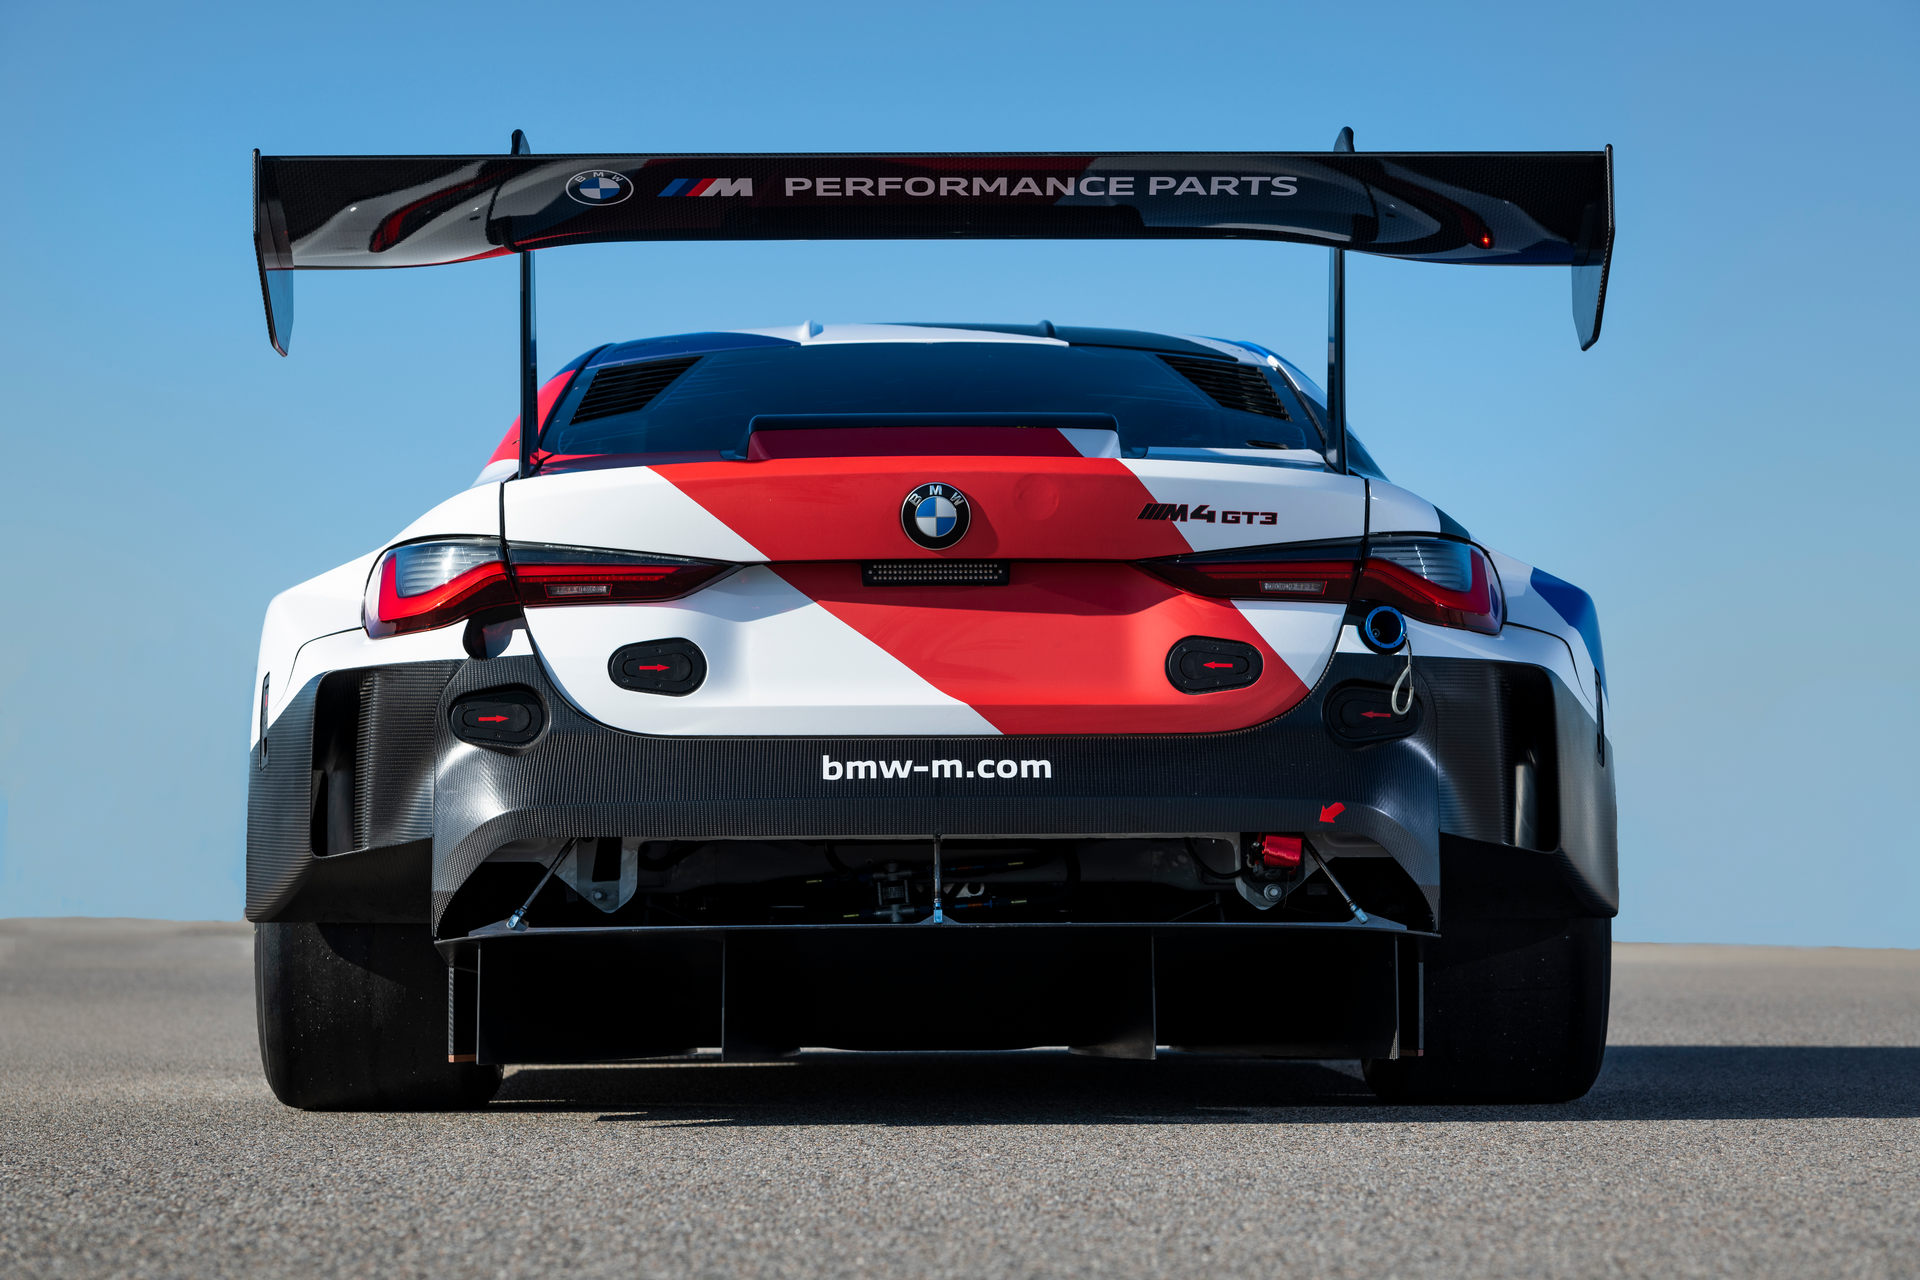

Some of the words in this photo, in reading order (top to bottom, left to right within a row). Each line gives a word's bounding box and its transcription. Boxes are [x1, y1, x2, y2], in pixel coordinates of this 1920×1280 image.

[575, 172, 624, 183] BMW
[785, 177, 1134, 197] PERFORMANCE
[1149, 176, 1298, 196] PARTS
[909, 485, 964, 506] BMW
[1221, 511, 1278, 525] GT3
[822, 755, 1052, 780] bmw-m.com
